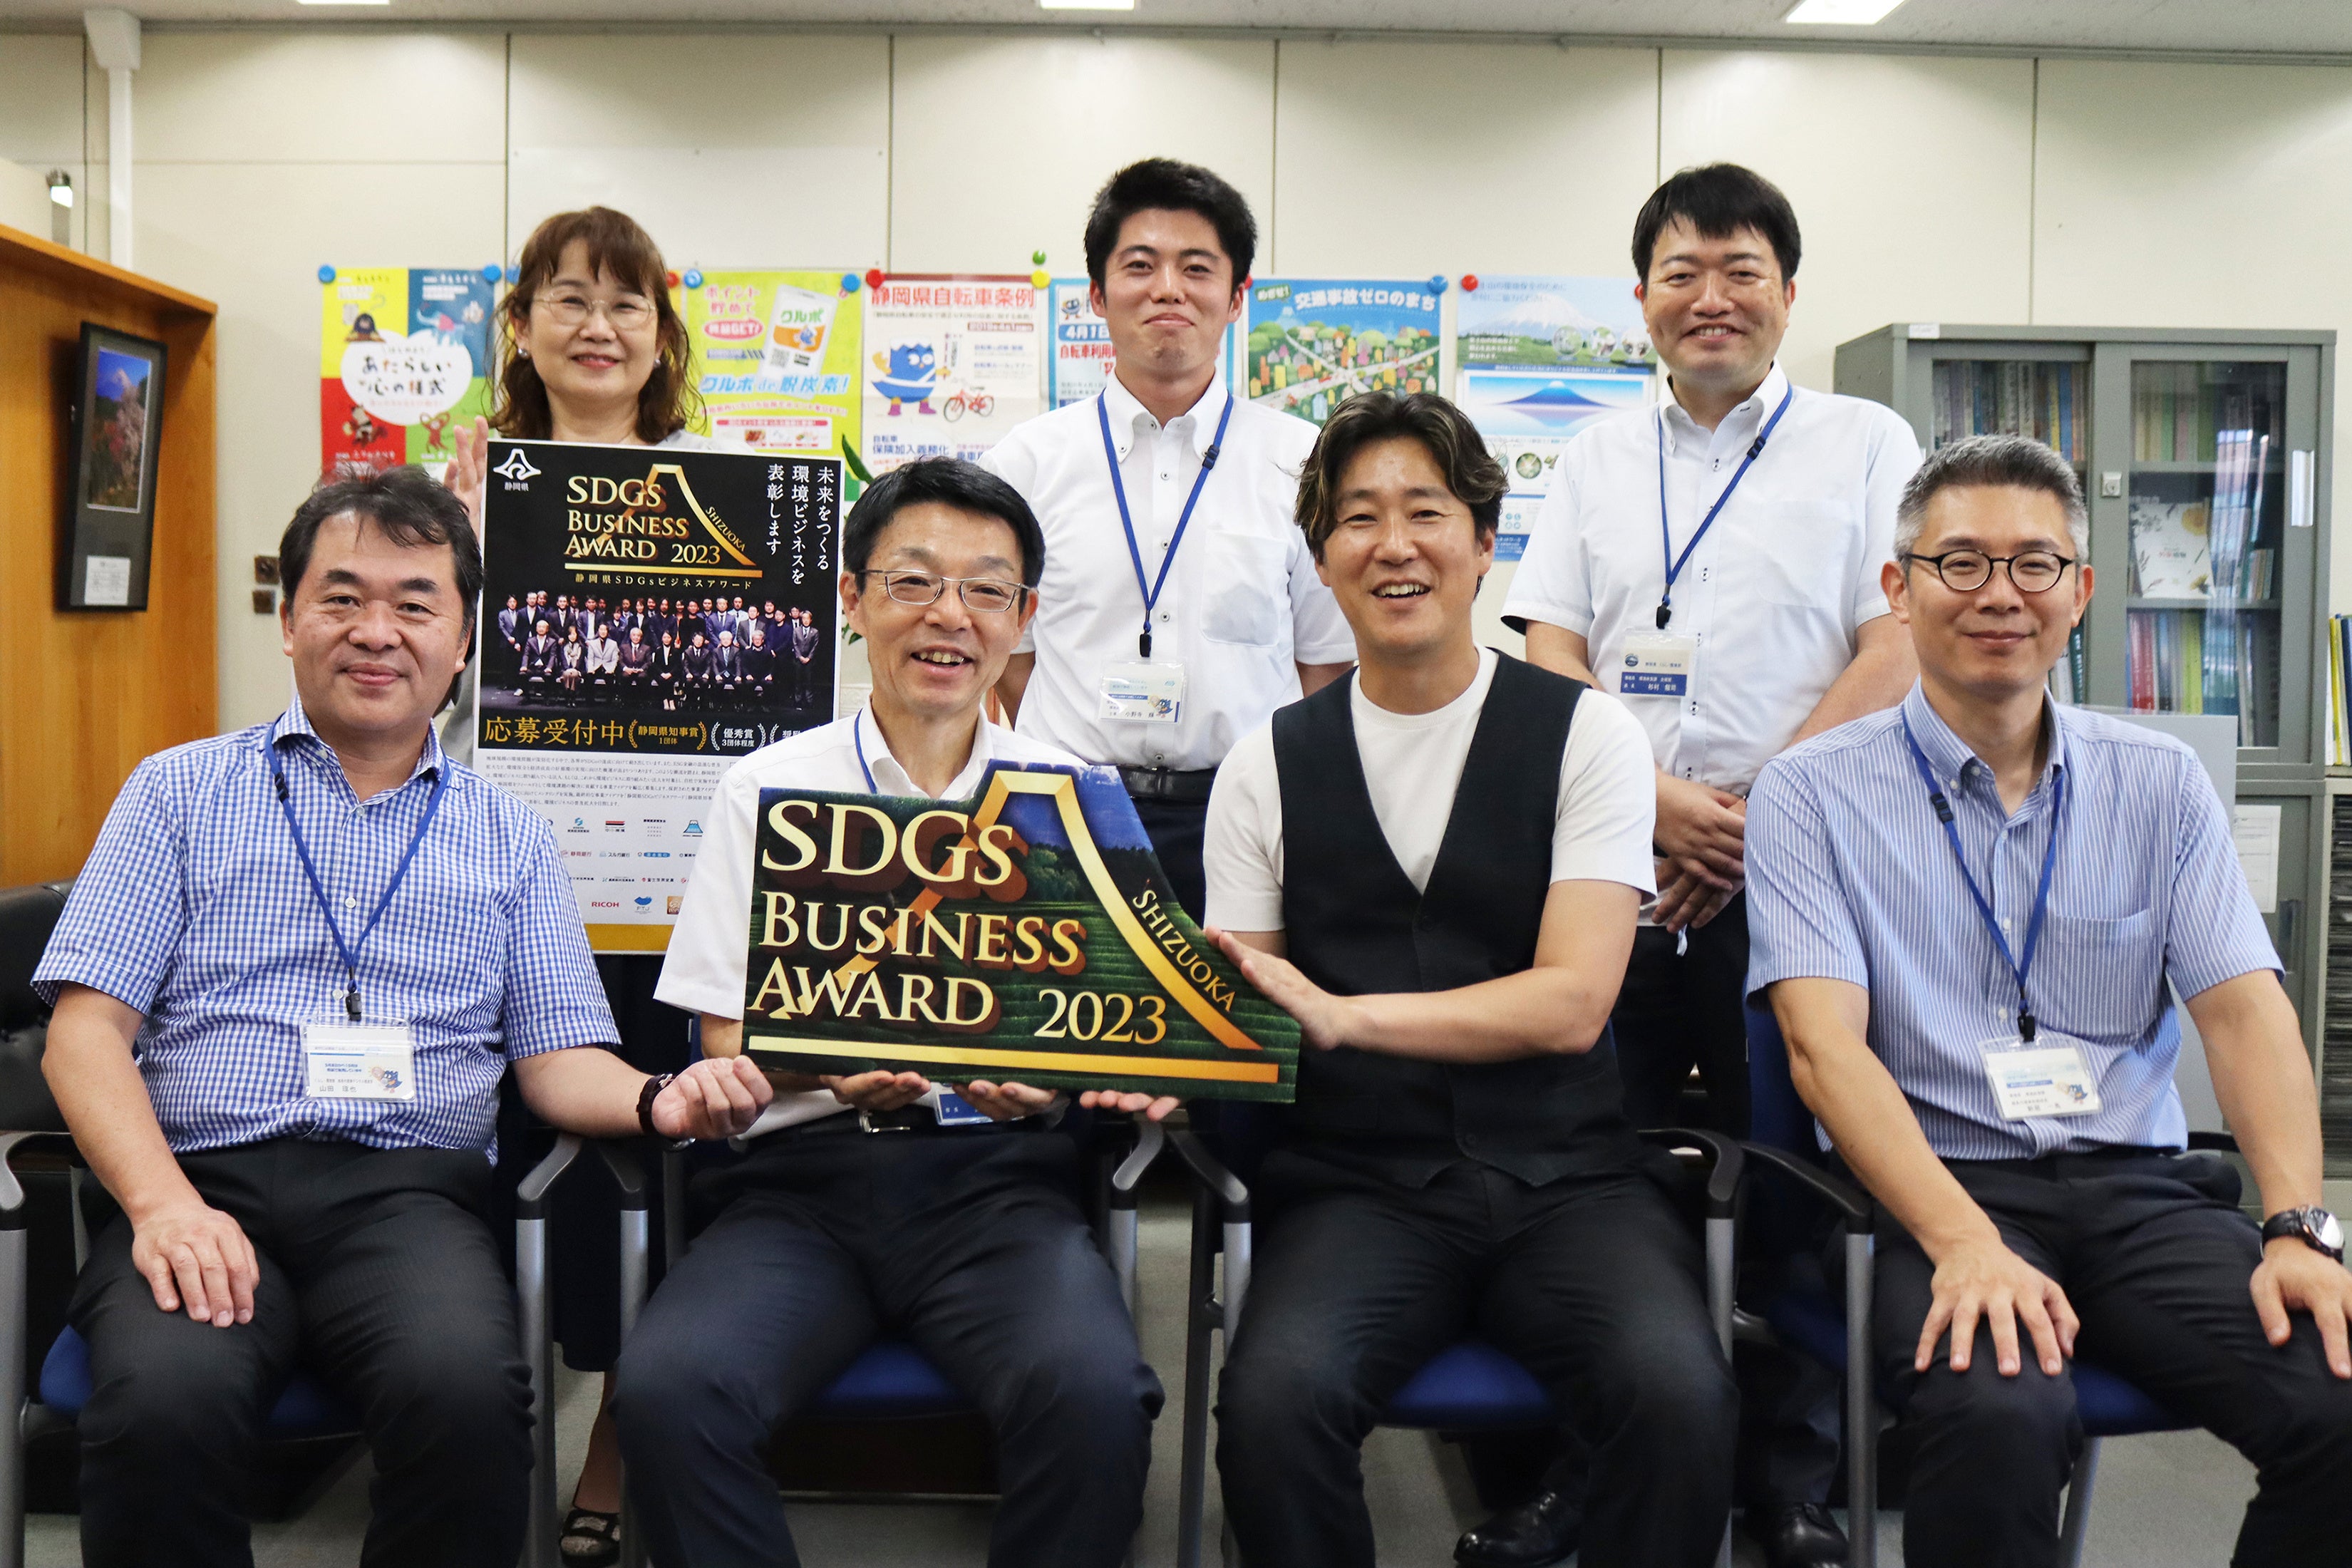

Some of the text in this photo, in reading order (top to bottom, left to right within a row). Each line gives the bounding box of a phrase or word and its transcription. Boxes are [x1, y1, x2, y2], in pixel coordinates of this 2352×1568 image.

[705, 286, 759, 299] ポイント
[872, 287, 1033, 307] 静岡県自転車条例
[1294, 289, 1436, 311] 交通事故ゼロのまち
[781, 309, 822, 323] クルポ
[1066, 325, 1110, 339] 4月1日
[362, 356, 452, 373] あたらしい
[368, 378, 446, 396] 心の様式
[701, 377, 752, 392] クルポ
[781, 377, 849, 393] 脱炭素!
[873, 445, 949, 455] 保険加入義務化
[505, 482, 529, 491] 静岡県
[766, 463, 785, 555] 表彰します
[816, 466, 835, 570] 未来をつくる
[567, 510, 688, 537] BUSINESS
[706, 506, 746, 552] SHIZUOKA
[791, 465, 810, 585] 環境ビジネスを
[564, 534, 721, 564] AWARD 2023
[575, 573, 752, 590] 静岡県SDGsビジネスアワード
[485, 716, 624, 746] 応募受付中
[638, 726, 699, 738] 静岡県知事賞
[723, 728, 754, 739] 優秀賞
[722, 739, 755, 748] 3団体程度
[759, 891, 1081, 969] BUSINESS
[1132, 889, 1237, 1013] SHIZUOKA
[747, 956, 1167, 1045] AWARD 2023
